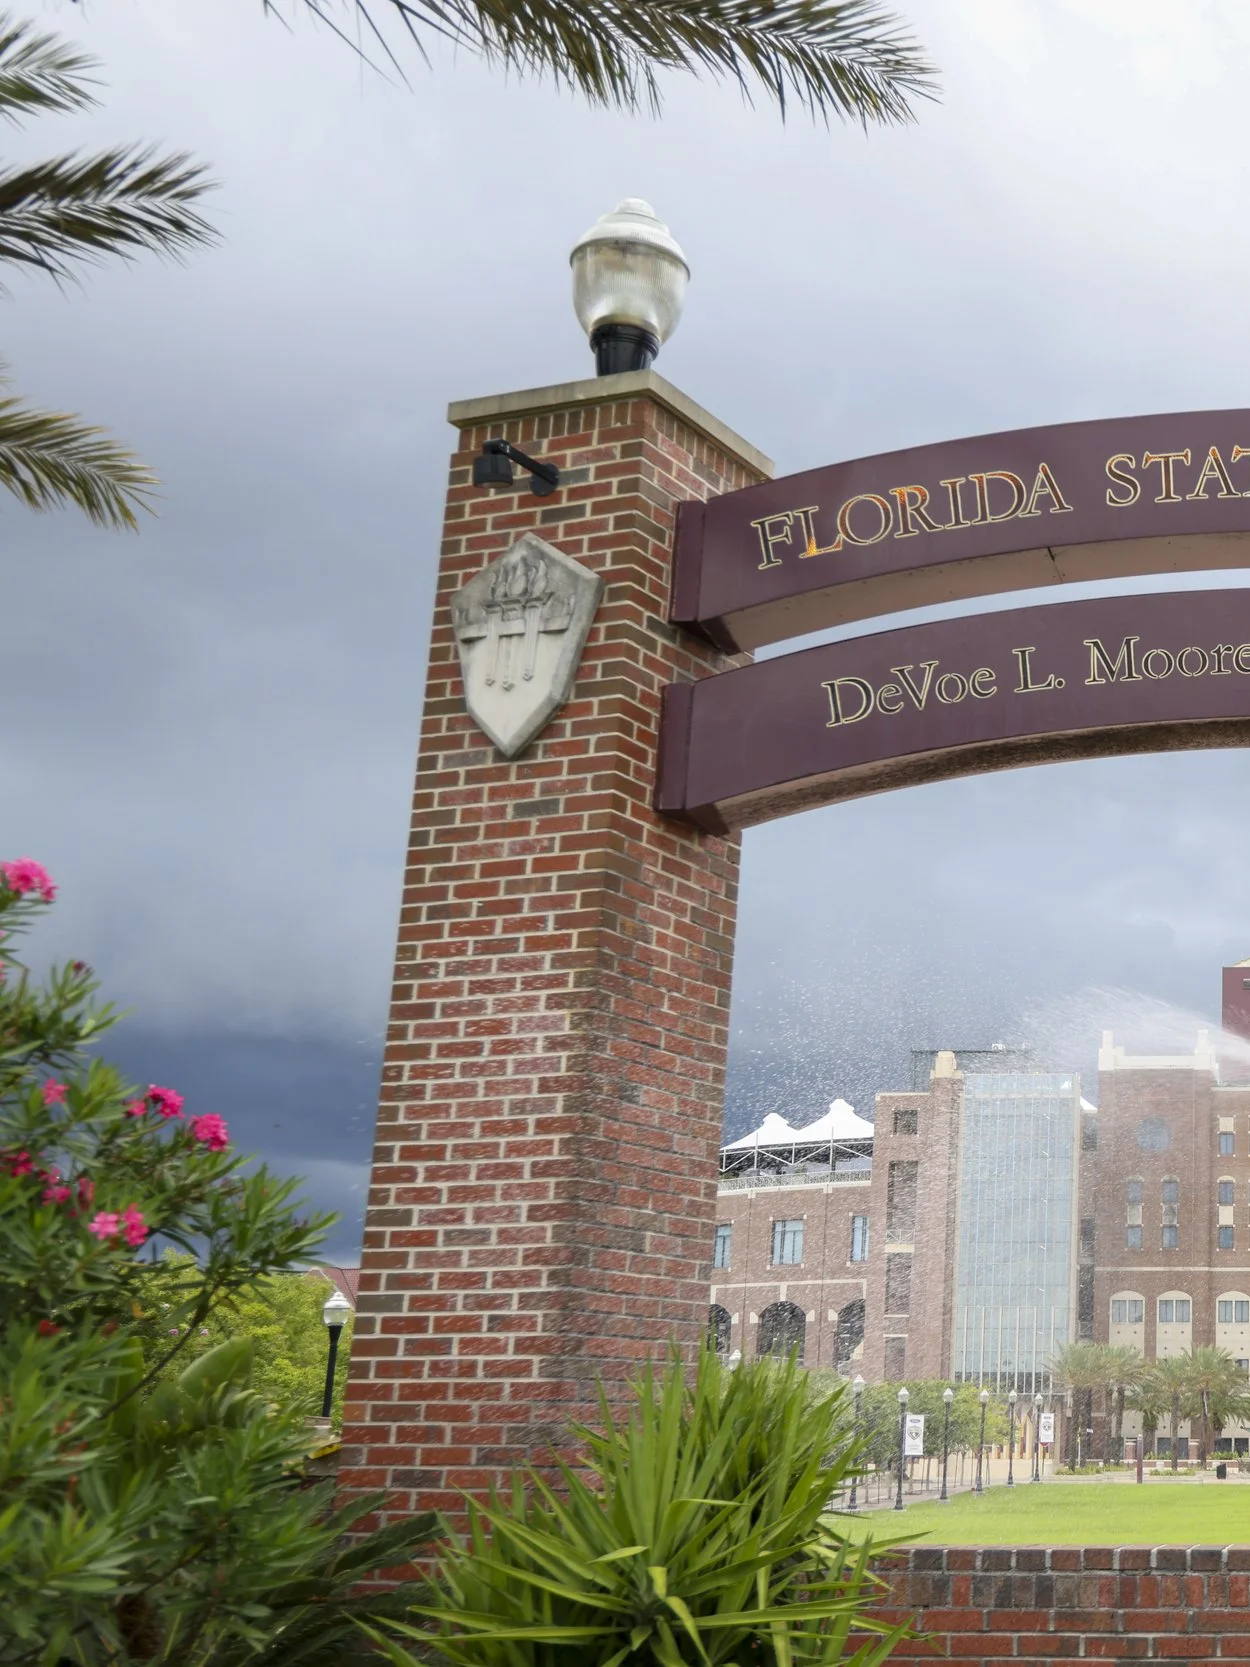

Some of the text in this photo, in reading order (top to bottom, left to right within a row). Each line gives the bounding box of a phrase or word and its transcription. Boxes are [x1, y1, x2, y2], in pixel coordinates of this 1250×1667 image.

[750, 463, 1074, 570] FLORIDA
[821, 660, 997, 728] DeVoe
[1012, 646, 1066, 693] L.
